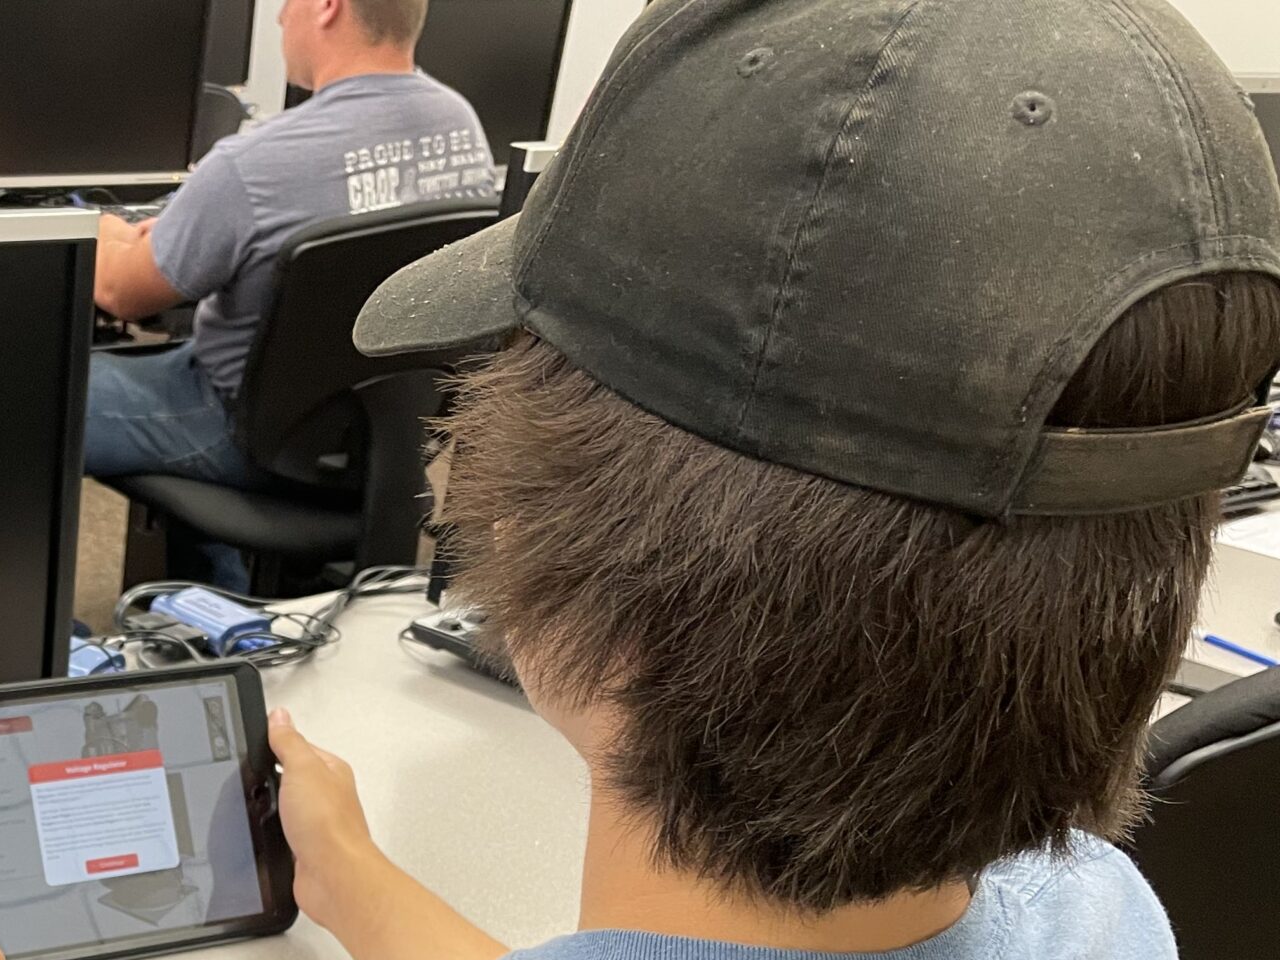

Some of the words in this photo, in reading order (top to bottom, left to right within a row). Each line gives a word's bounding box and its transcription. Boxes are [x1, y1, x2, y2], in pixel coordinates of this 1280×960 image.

[344, 139, 414, 173] PROUD
[419, 133, 446, 157] TO
[347, 166, 400, 211] CROP
